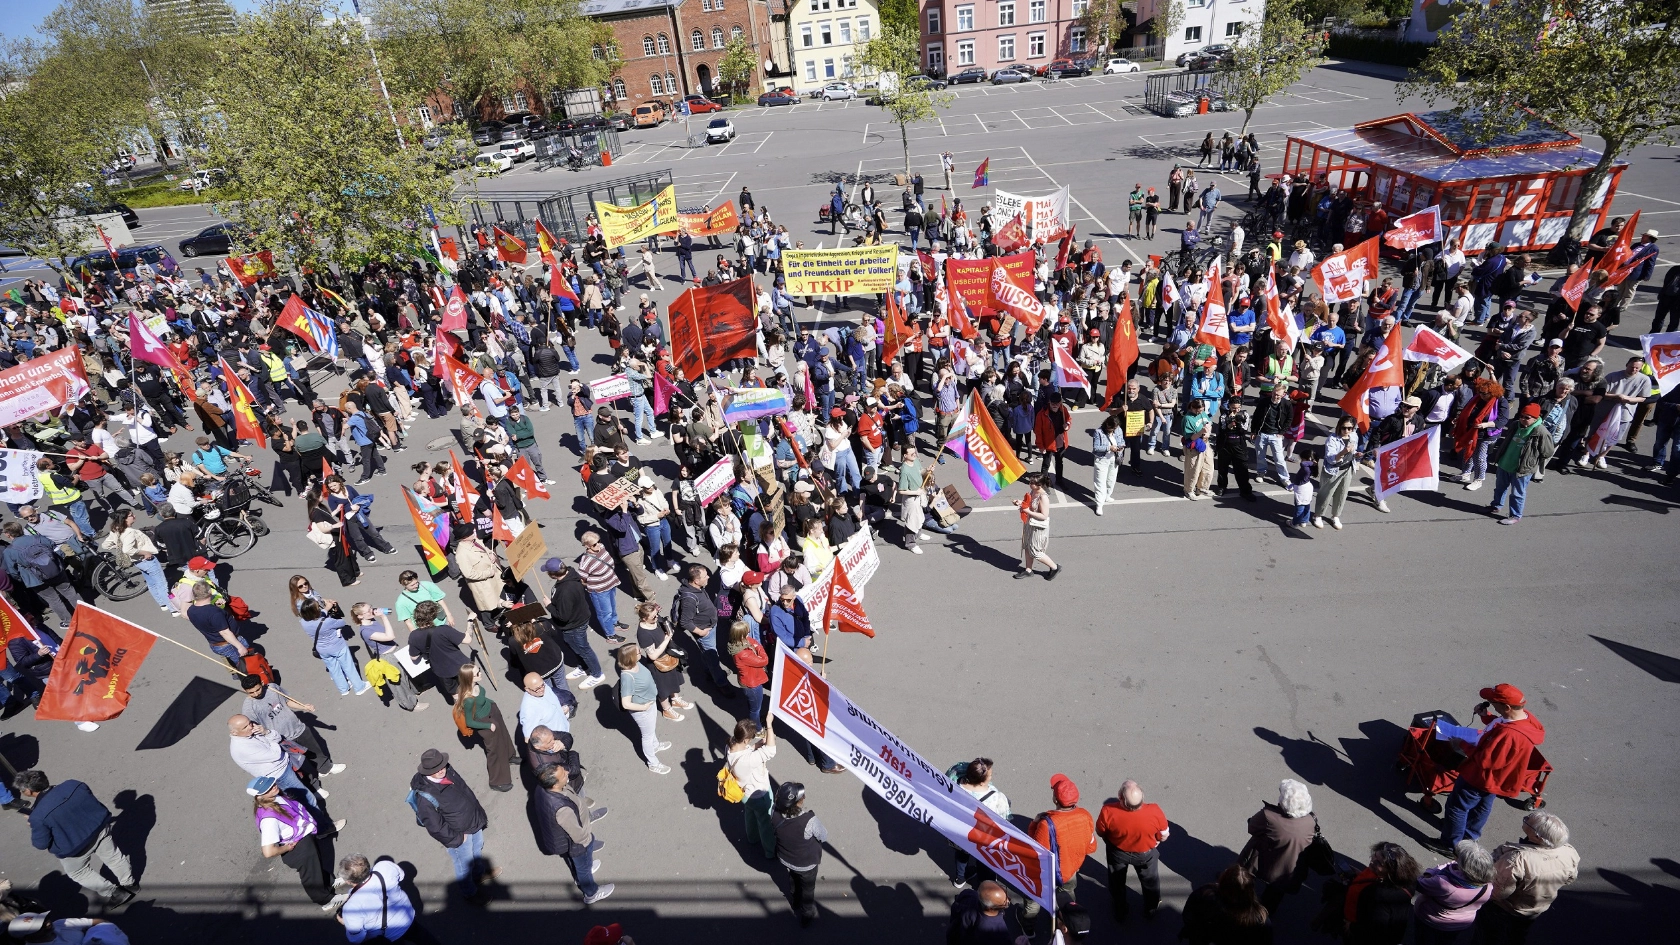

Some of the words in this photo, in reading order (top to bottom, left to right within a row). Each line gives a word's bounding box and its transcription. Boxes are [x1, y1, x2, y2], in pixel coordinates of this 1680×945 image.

[1024, 201, 1033, 240] 1
[1036, 209, 1054, 219] MAY
[788, 260, 800, 268] Für
[803, 260, 815, 268] die
[816, 259, 842, 267] Einheit
[844, 258, 857, 266] der
[859, 257, 890, 265] Arbeiter
[804, 268, 851, 277] Freundschaft
[853, 267, 866, 275] der
[868, 265, 894, 275] Völker!
[957, 266, 989, 274] KAPITALIS
[1000, 283, 1040, 312] JUSOS
[27, 362, 53, 377] uns
[54, 351, 77, 367] ein!
[15, 383, 31, 393] und
[31, 367, 76, 386] Erwerbslse
[966, 434, 1002, 472] JUSOS
[833, 584, 860, 606] SPD
